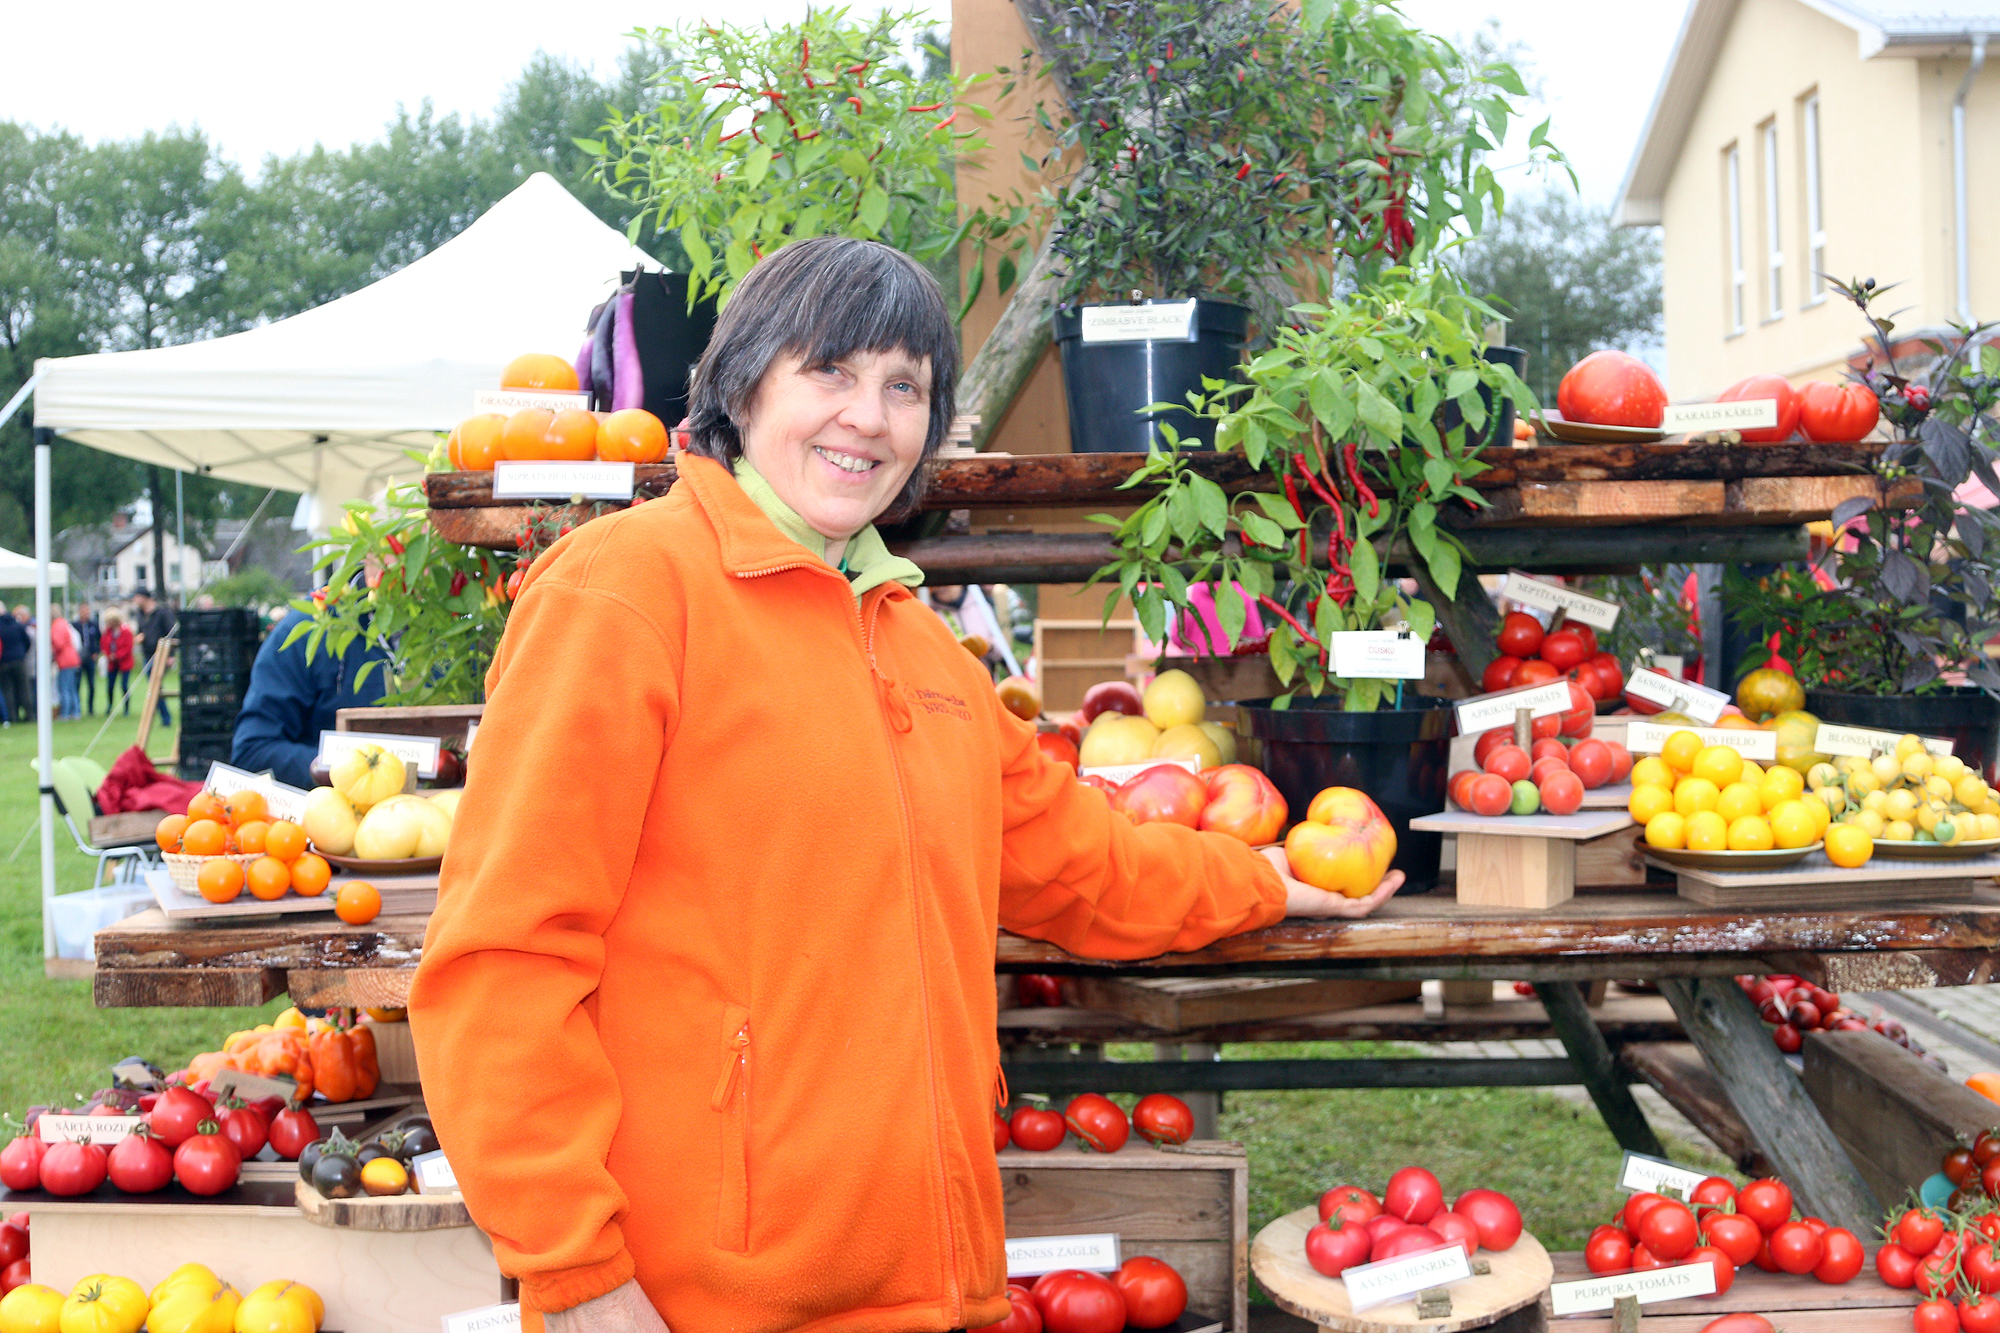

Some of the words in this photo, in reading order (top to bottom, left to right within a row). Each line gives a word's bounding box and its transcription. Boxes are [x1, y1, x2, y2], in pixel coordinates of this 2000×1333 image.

[1720, 735, 1757, 747] HELIO
[55, 1120, 93, 1132] SĀRTĀ
[96, 1121, 127, 1132] ROZE
[1056, 1244, 1100, 1258] ZAGLIS
[1405, 1255, 1458, 1281] HENRIKS
[1574, 1281, 1635, 1300] PURPURA
[1637, 1273, 1691, 1291] TOMĀTS
